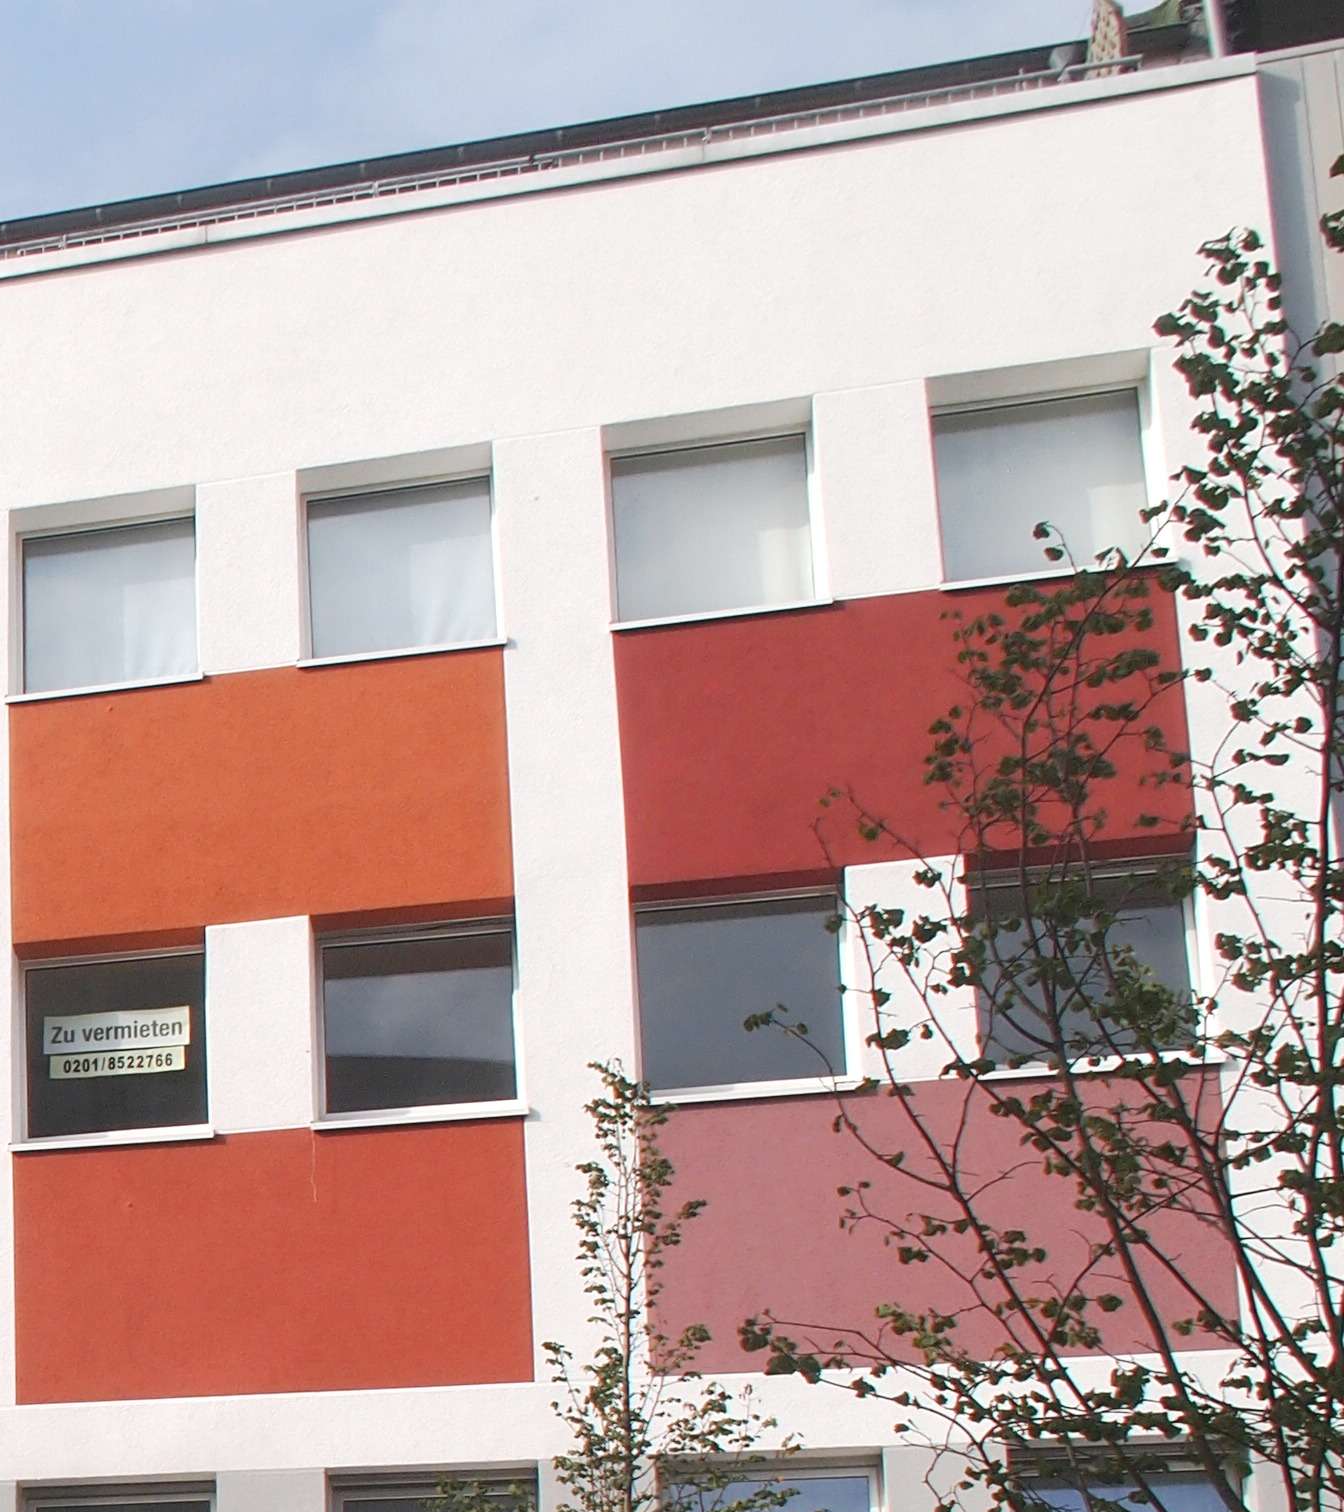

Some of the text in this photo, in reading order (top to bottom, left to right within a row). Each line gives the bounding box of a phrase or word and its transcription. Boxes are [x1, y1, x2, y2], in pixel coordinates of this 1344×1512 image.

[50, 1019, 184, 1045] Zu vermieten
[62, 1052, 174, 1074] 0201/8522766
